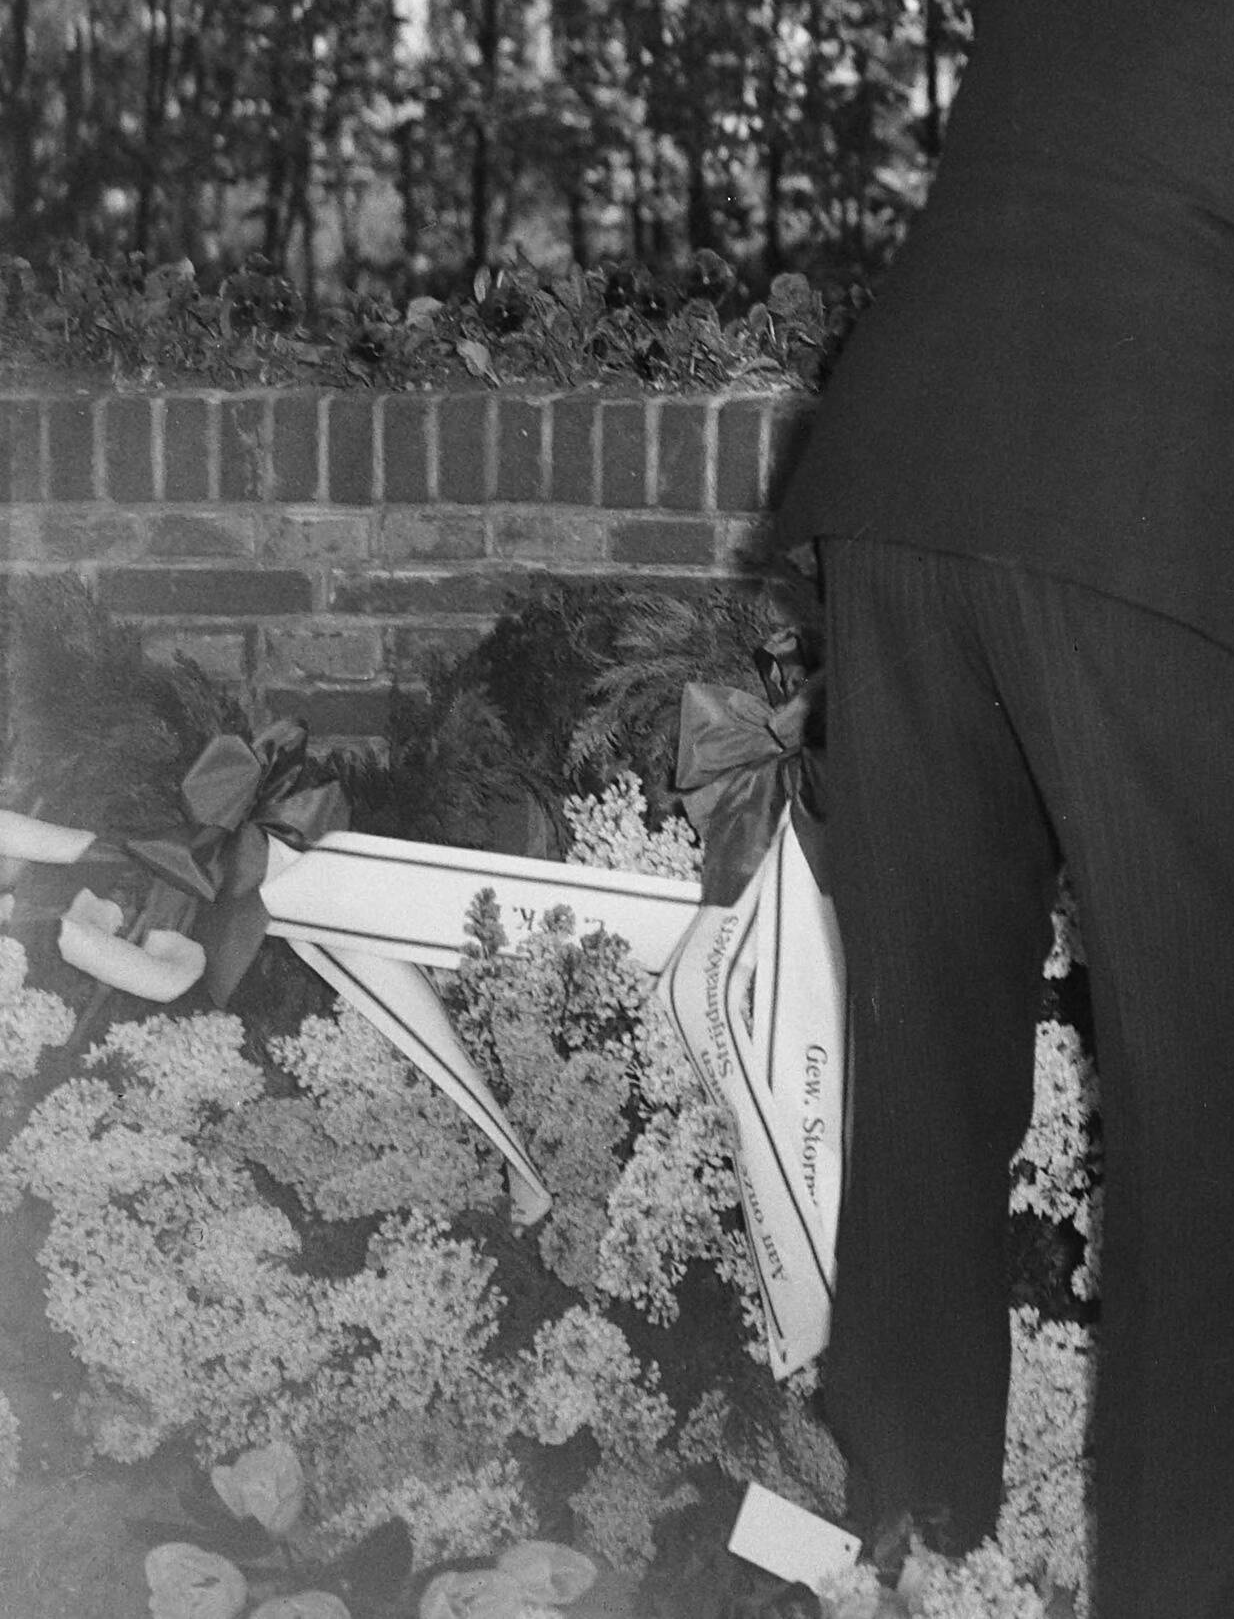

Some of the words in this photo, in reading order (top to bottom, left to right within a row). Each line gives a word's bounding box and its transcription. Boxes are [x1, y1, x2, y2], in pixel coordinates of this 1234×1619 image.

[704, 914, 740, 1080] Strijdmakkers
[804, 1044, 828, 1106] Gew.
[761, 1234, 785, 1280] Aan
